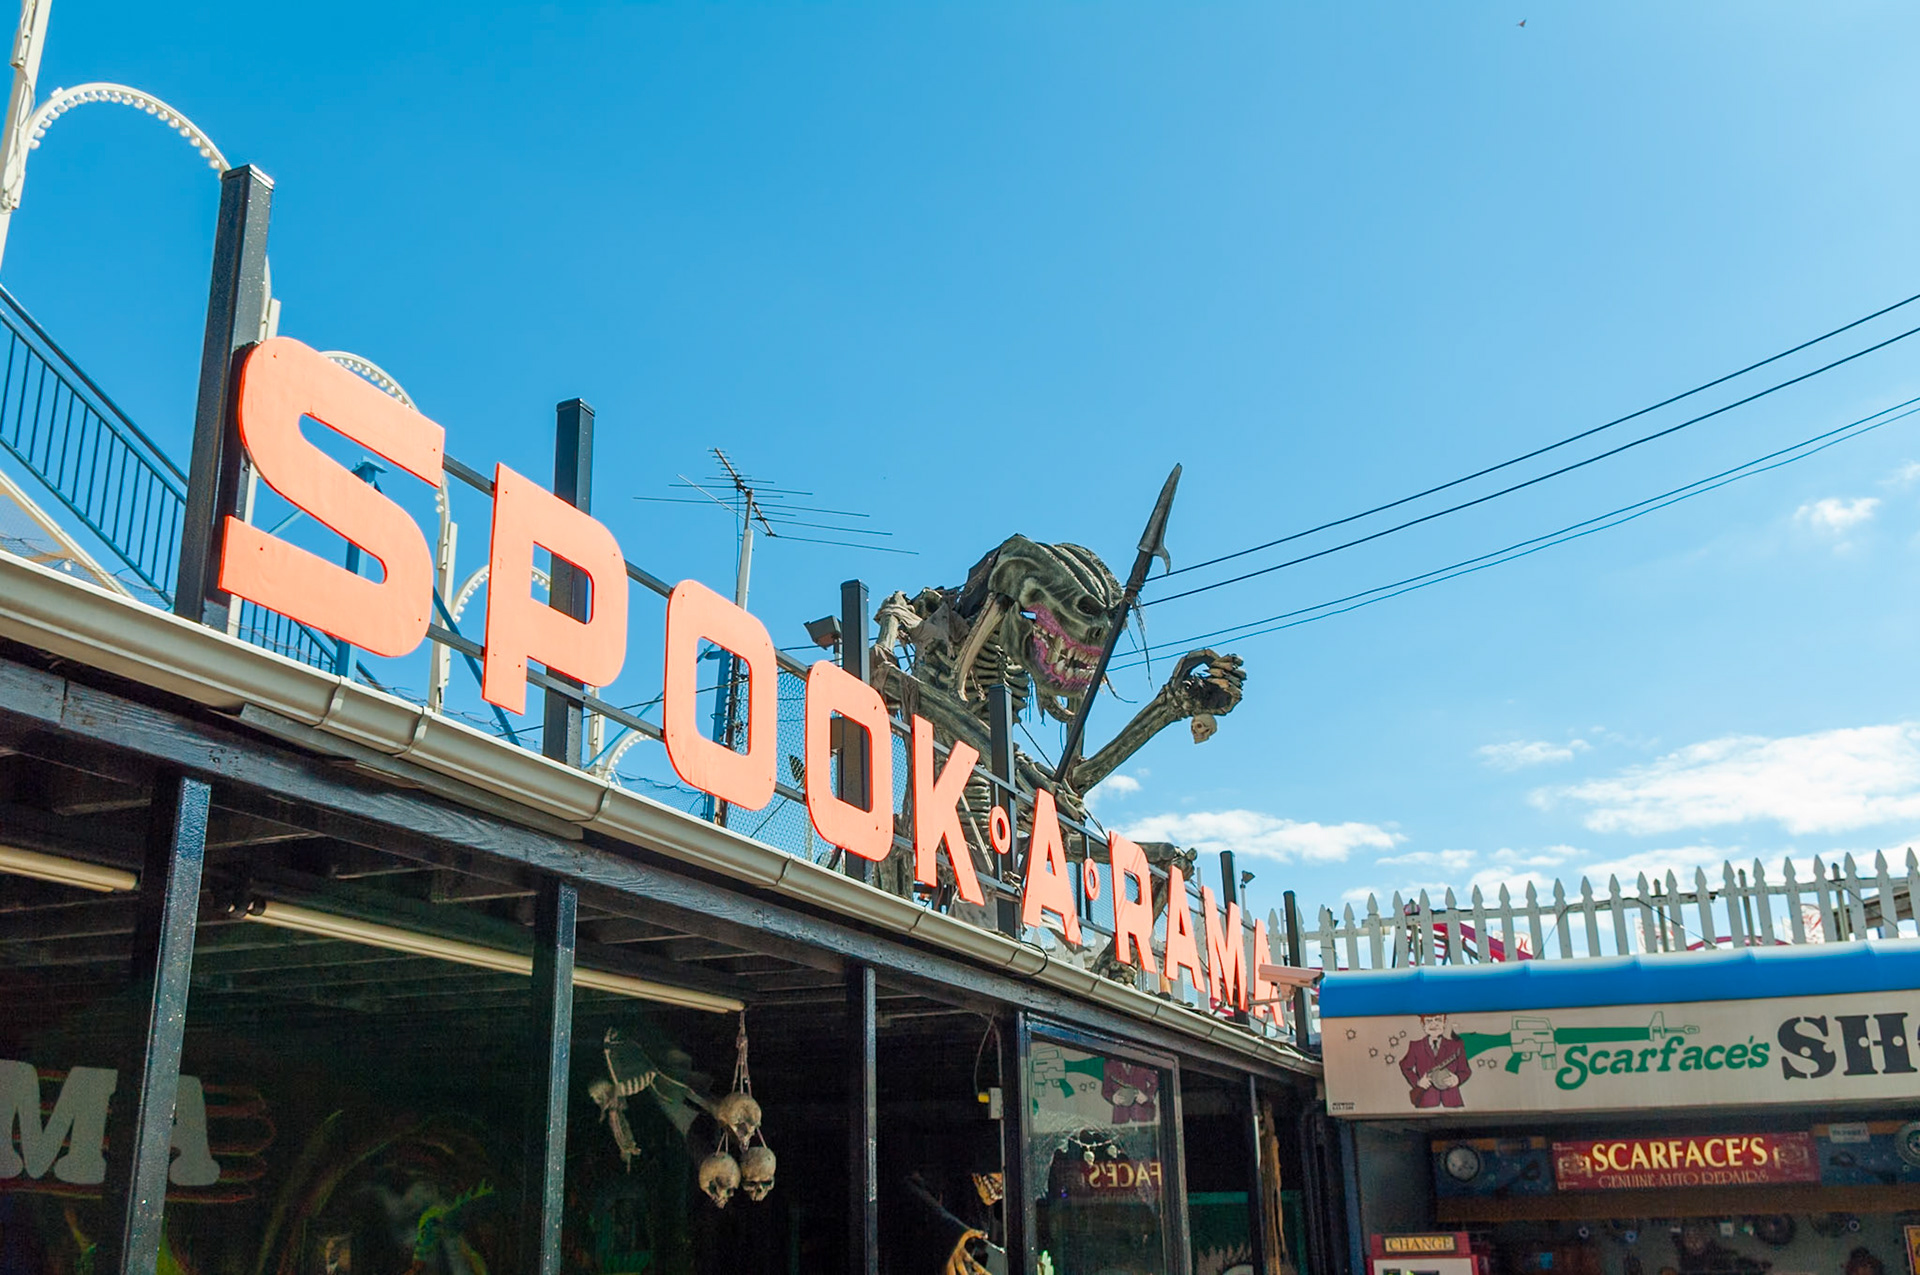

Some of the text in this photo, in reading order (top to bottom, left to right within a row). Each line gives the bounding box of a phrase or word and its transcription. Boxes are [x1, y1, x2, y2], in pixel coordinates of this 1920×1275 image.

[217, 335, 985, 907] SPOOK
[1555, 1012, 1920, 1090] Scarface's SH
[1591, 1137, 1768, 1172] SCARFACE'S
[1658, 1171, 1699, 1187] AUTO
[1388, 1237, 1454, 1251] CHANGE
